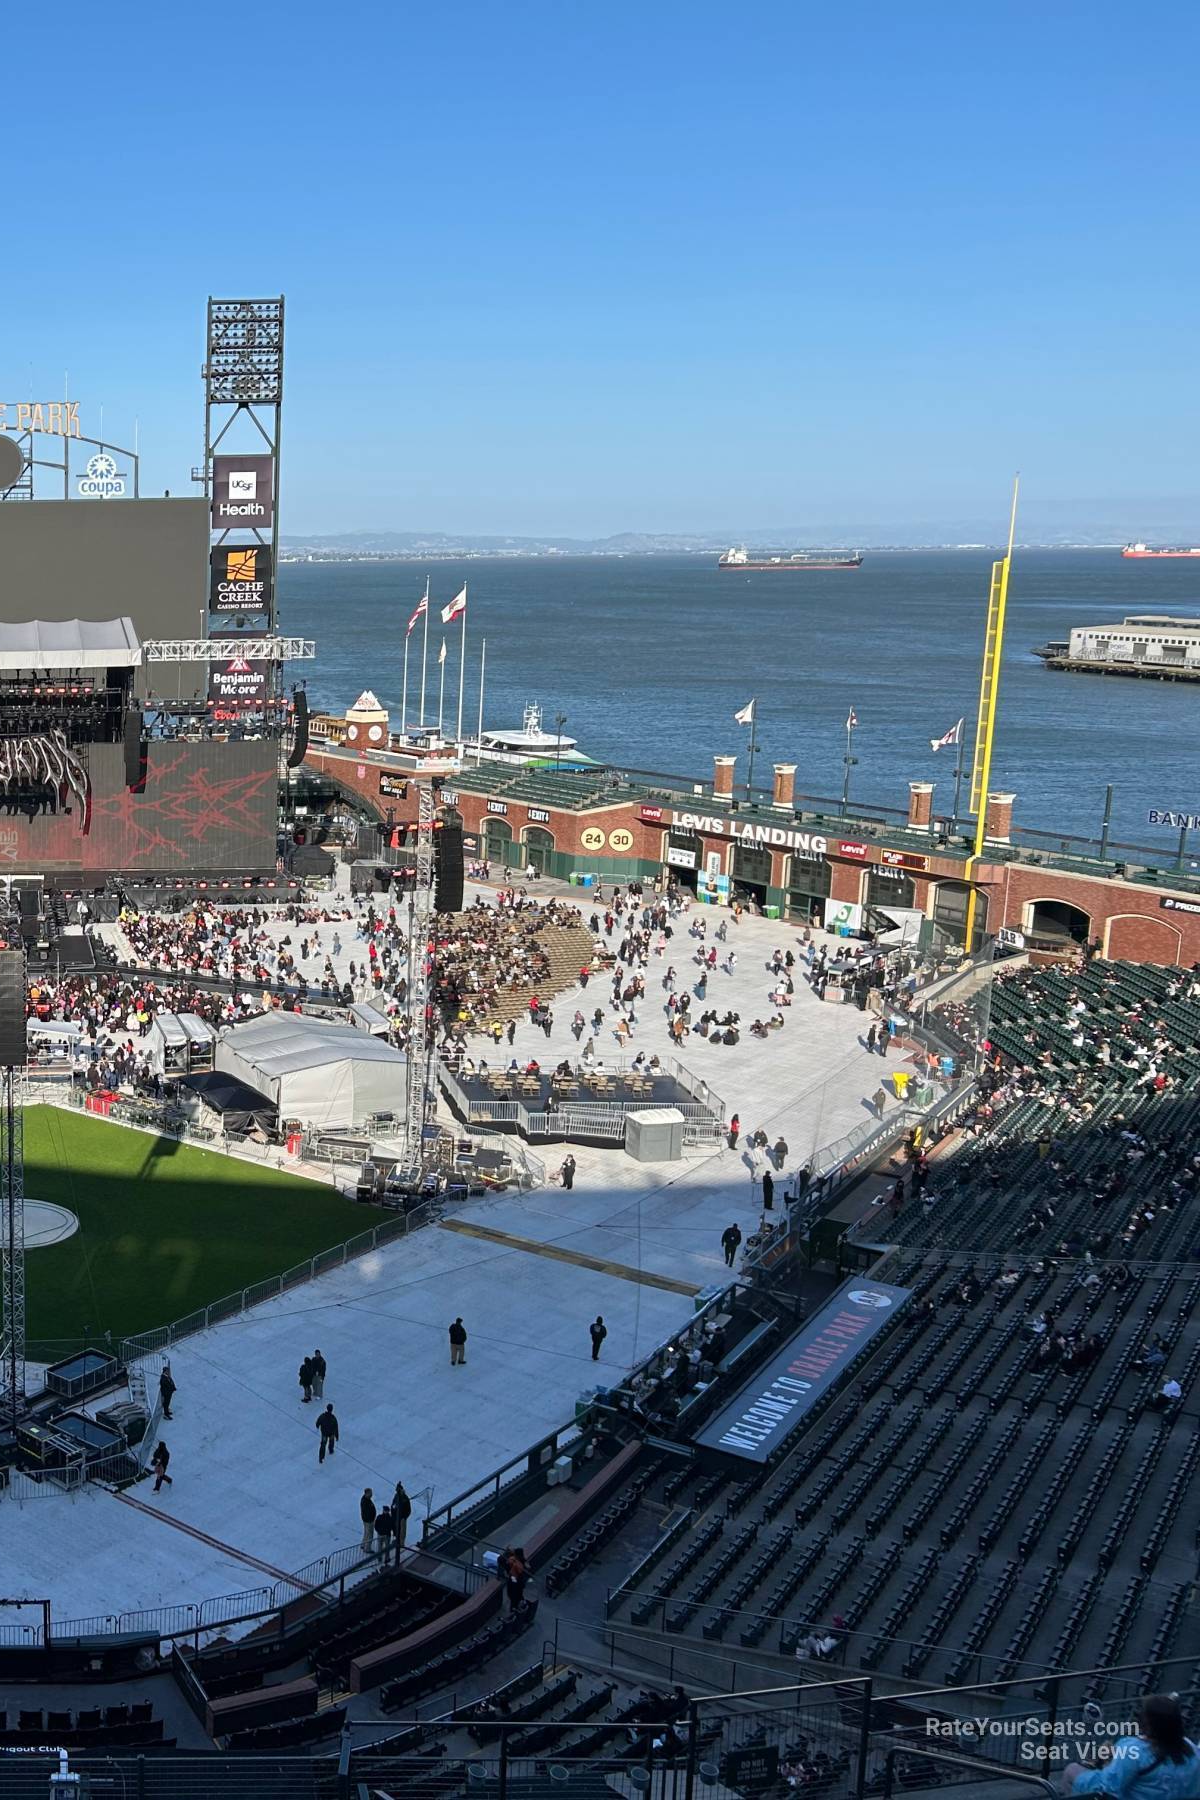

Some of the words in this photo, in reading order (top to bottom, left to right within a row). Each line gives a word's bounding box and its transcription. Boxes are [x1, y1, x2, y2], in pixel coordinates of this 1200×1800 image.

[16, 401, 82, 439] PARK
[81, 480, 122, 495] coupa
[219, 503, 264, 516] Health
[218, 582, 264, 592] CACHE
[218, 592, 262, 602] CREEK
[213, 672, 264, 685] Benjamin
[490, 802, 504, 813] EXIT
[531, 810, 546, 821] EXIT
[585, 834, 601, 844] 24
[613, 835, 629, 845] 30
[730, 821, 827, 853] LANDING
[878, 867, 899, 880] EXIT
[944, 944, 964, 956] 309
[823, 1311, 873, 1341] PARK
[787, 1337, 848, 1379] ORACLE
[772, 1376, 813, 1394] TO
[719, 1391, 799, 1451] WELCOME
